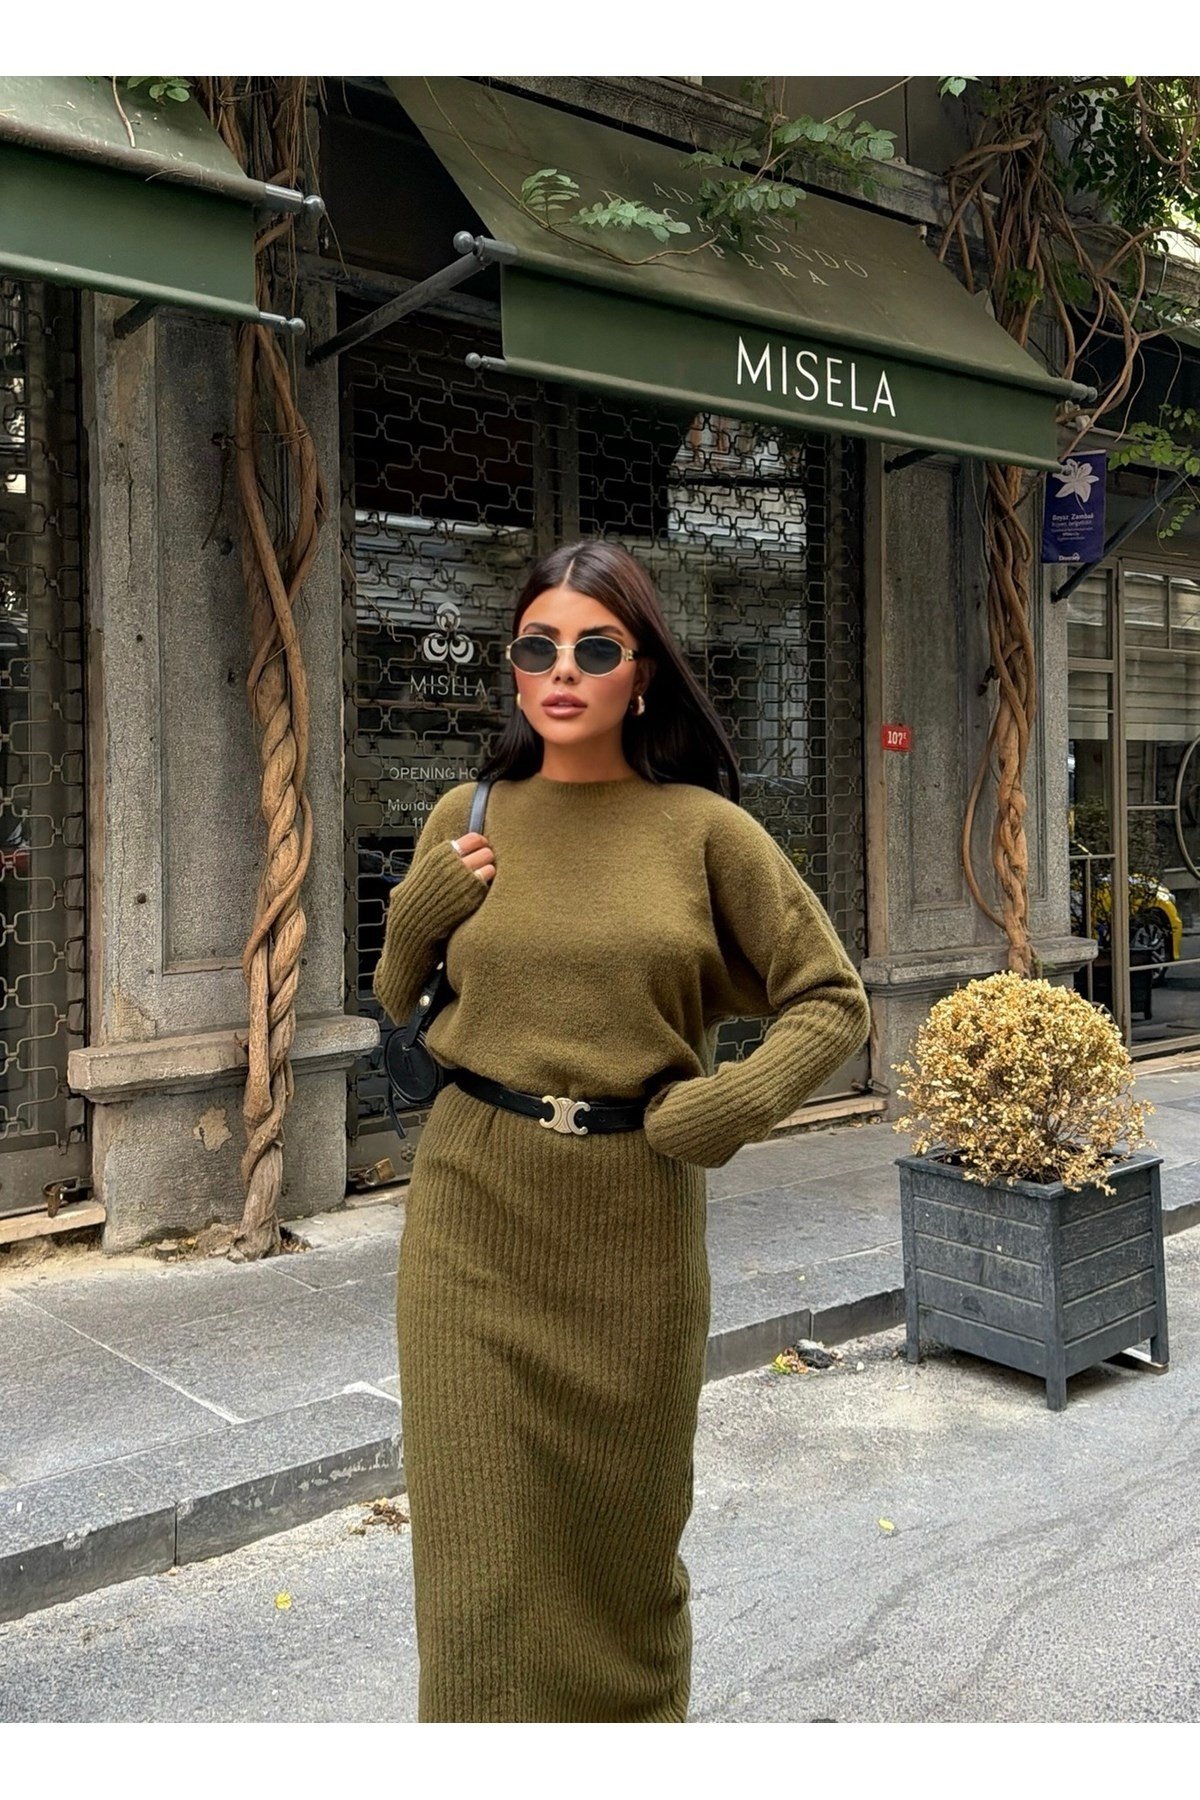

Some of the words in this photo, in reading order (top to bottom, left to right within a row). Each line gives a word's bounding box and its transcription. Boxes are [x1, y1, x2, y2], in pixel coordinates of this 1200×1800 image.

[736, 335, 897, 418] MISELA
[410, 674, 488, 697] MISELA
[389, 766, 456, 780] OPENING
